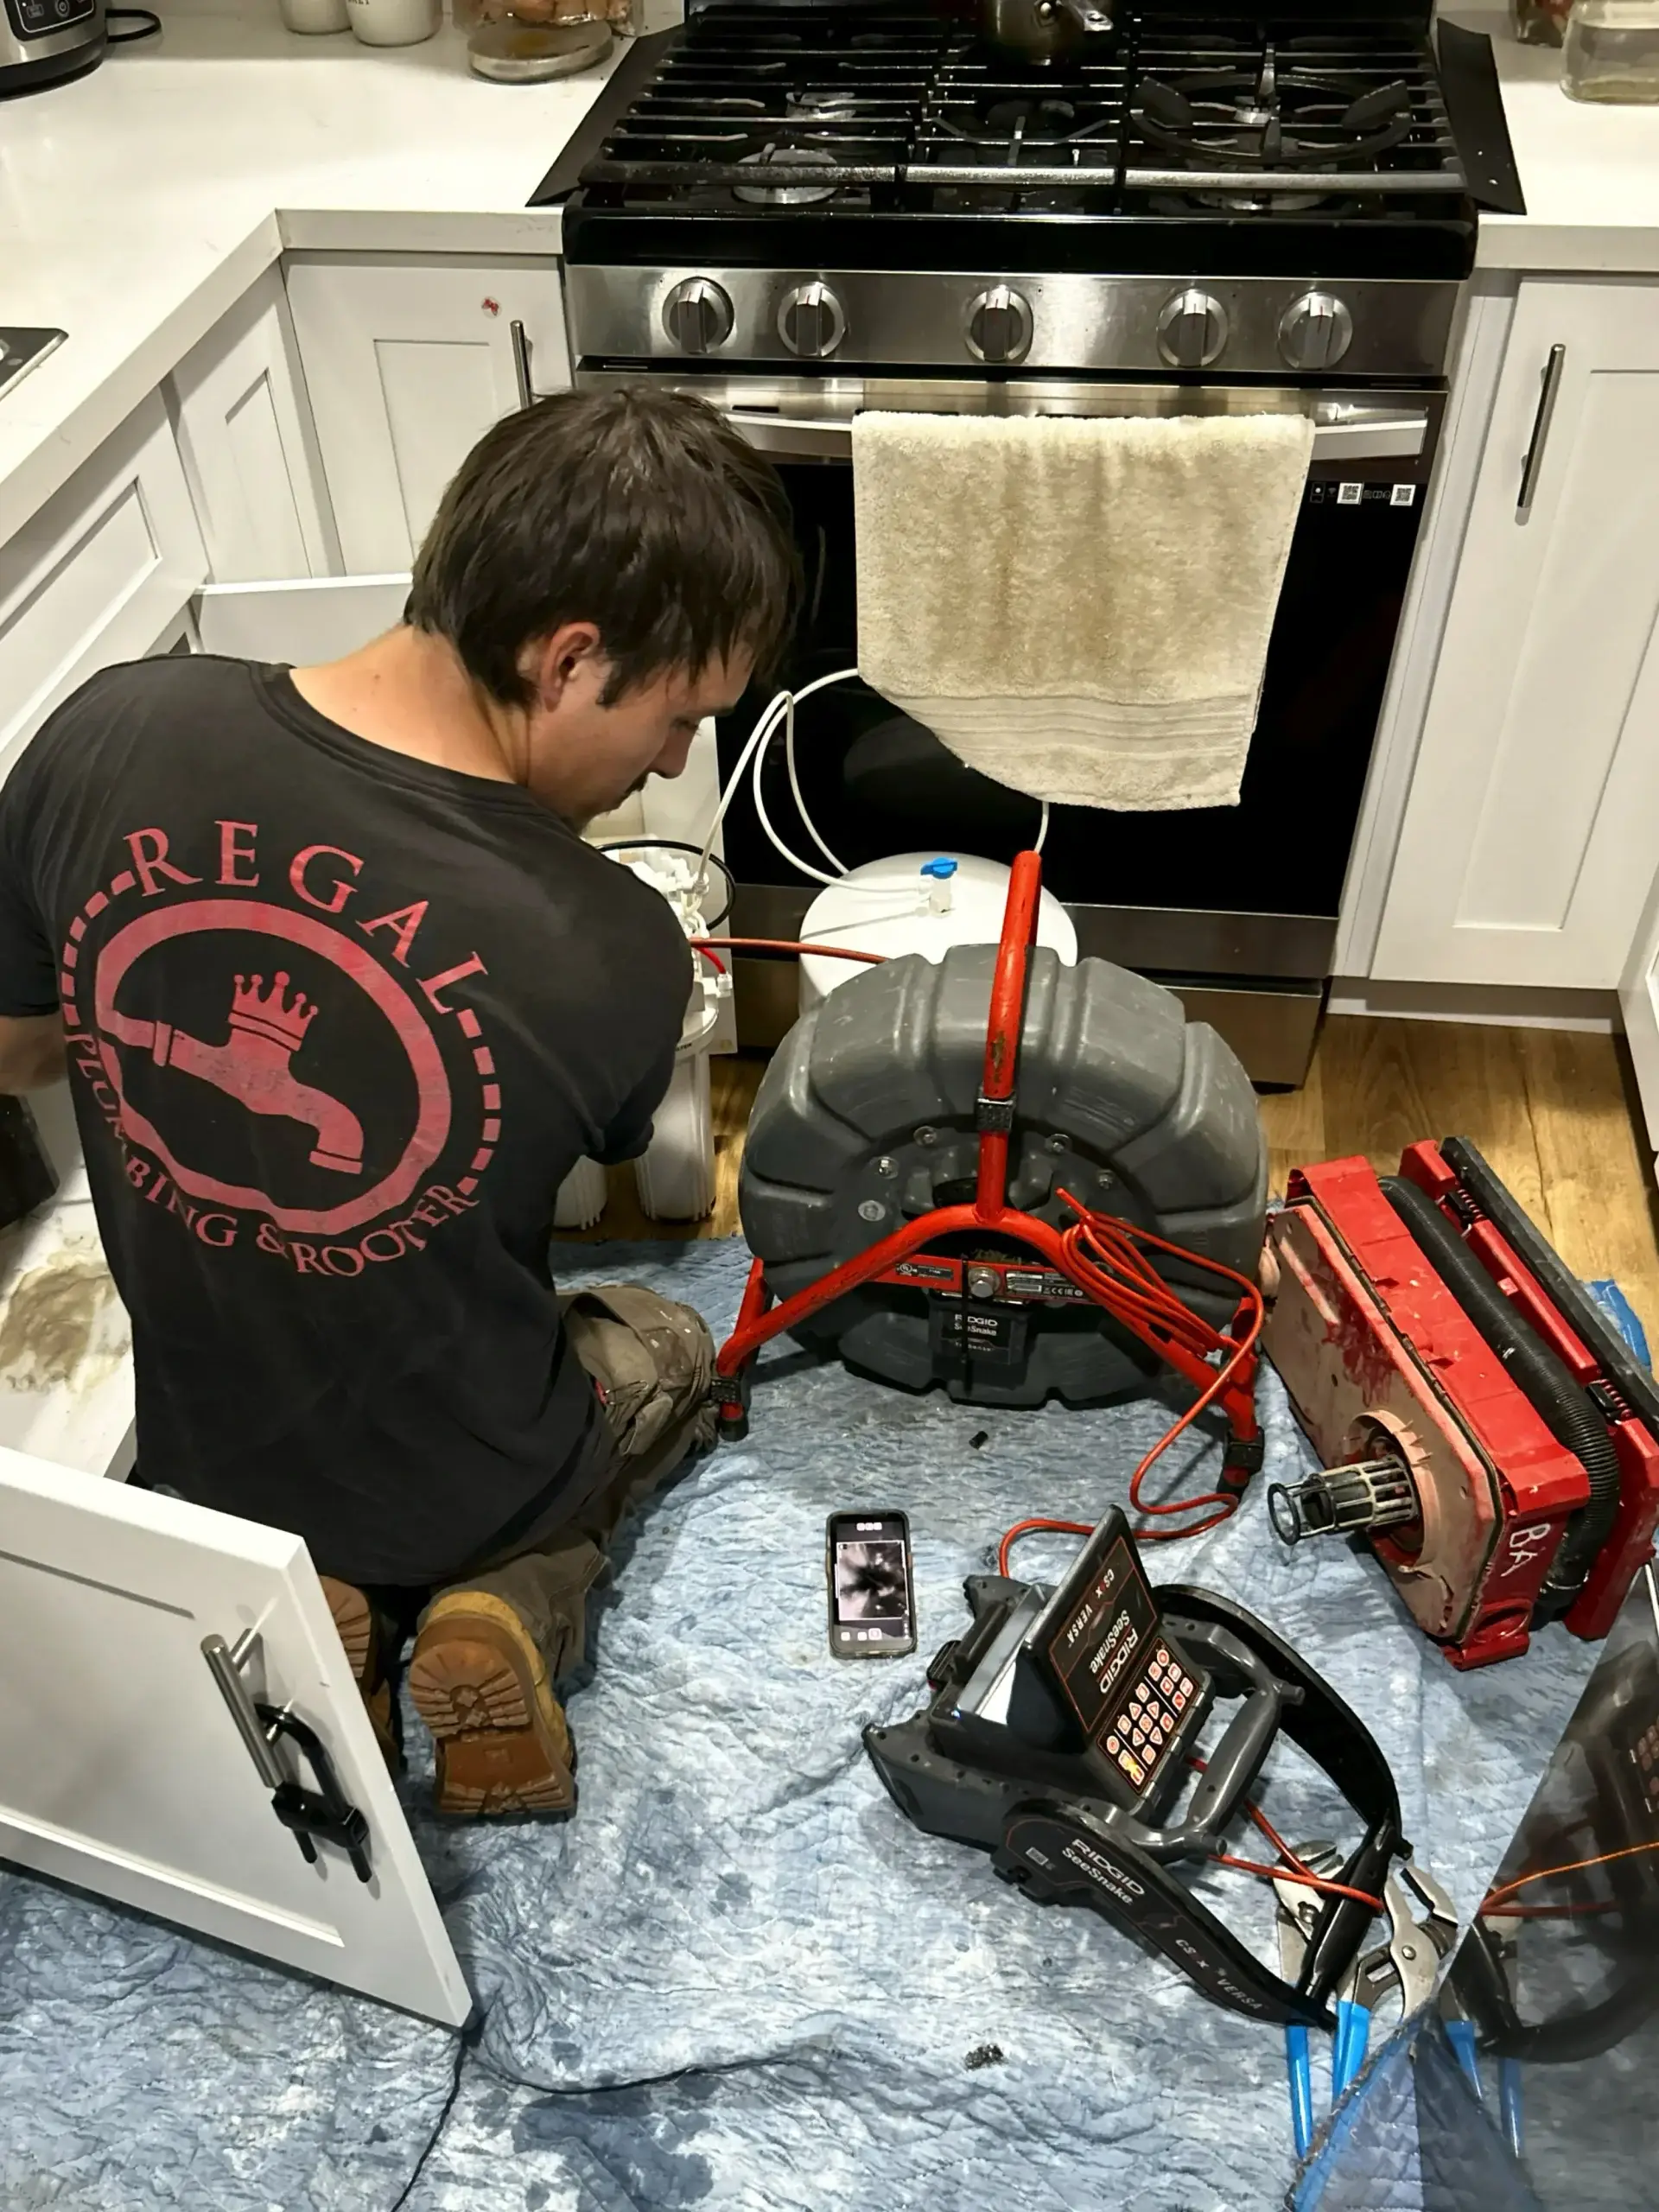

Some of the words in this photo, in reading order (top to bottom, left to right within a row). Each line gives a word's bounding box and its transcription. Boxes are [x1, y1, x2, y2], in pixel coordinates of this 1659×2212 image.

[123, 820, 488, 1014] REGAL
[256, 1223, 289, 1260] &
[288, 1185, 480, 1277] ROOTER
[954, 1313, 998, 1326] RDGID
[954, 1323, 997, 1336] SSnake
[1500, 1522, 1551, 1577] BA
[1066, 1604, 1093, 1643] VERSA
[1090, 1610, 1130, 1674] SeeSnake
[1100, 1628, 1139, 1694] RIDGID
[1062, 1847, 1134, 1904] SeeSnake
[1071, 1839, 1145, 1895] RIDGID
[1175, 1939, 1210, 1968] CSx
[1217, 1979, 1262, 2010] VERSA
